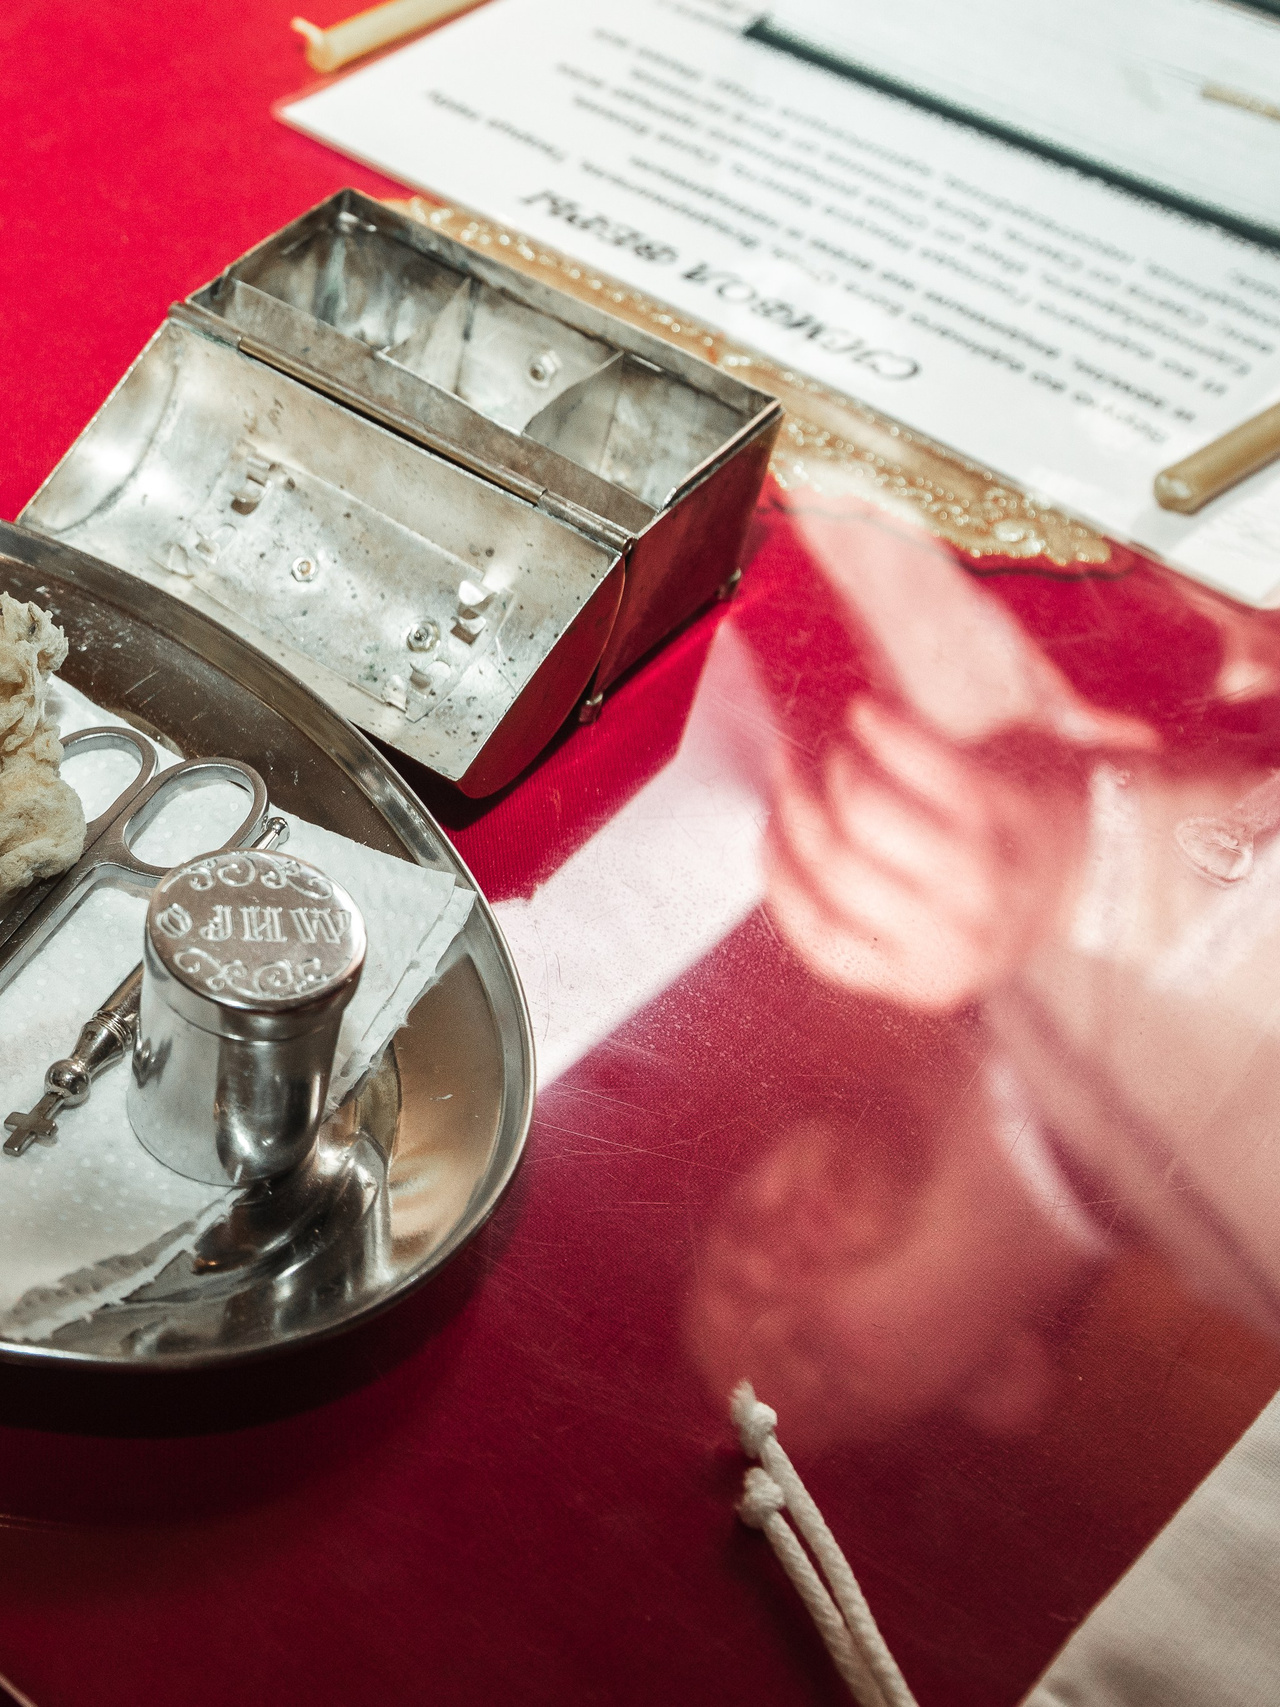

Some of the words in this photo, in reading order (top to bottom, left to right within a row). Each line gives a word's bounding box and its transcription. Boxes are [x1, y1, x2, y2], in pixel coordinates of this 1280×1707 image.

[521, 190, 678, 263] ВЕРЫ
[681, 262, 922, 380] СИМВОЛ
[154, 902, 352, 945] МИРО
